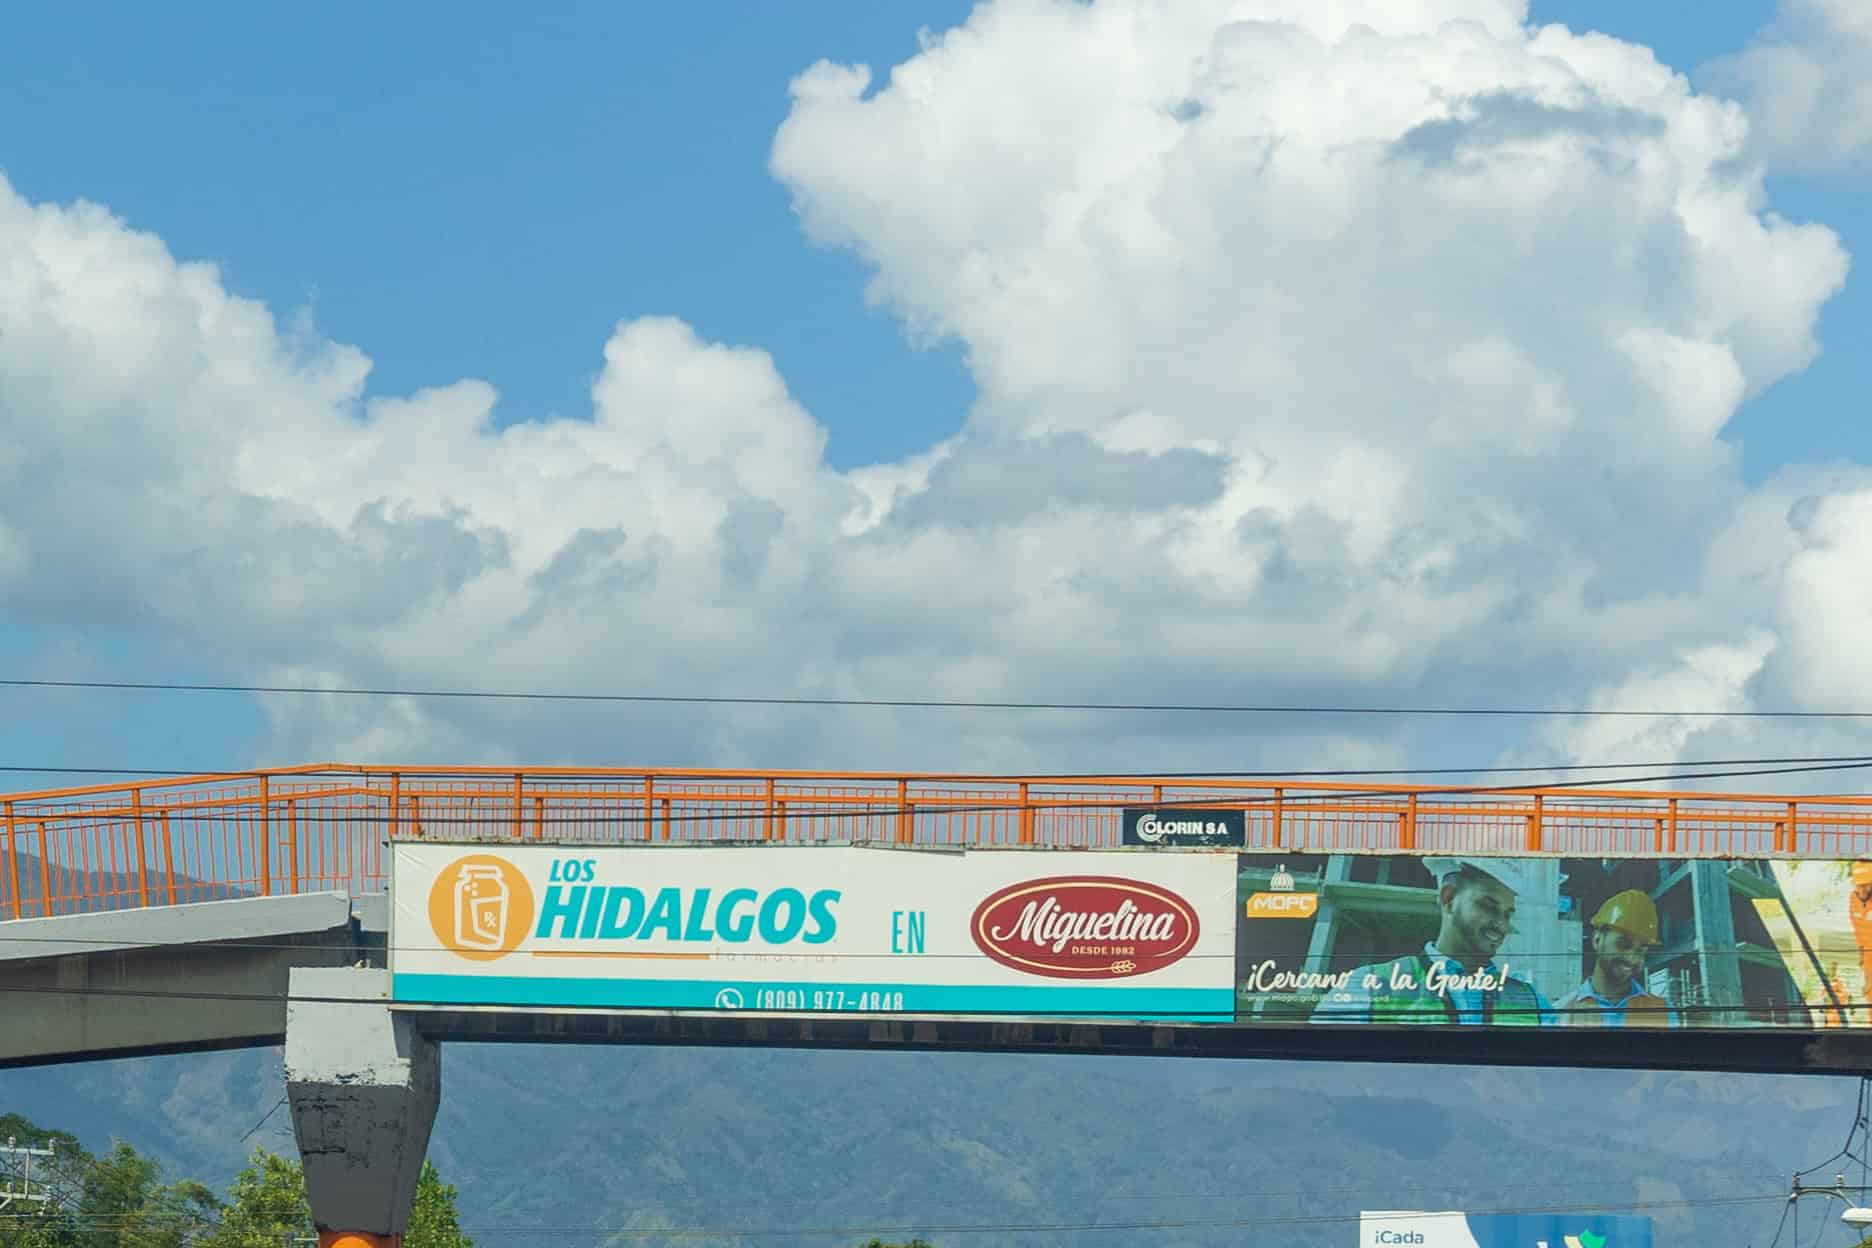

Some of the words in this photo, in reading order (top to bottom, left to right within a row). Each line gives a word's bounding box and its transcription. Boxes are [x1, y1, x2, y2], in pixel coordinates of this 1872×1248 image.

[1136, 814, 1204, 842] COLORIN
[1205, 822, 1228, 835] SA
[549, 859, 597, 882] LOS
[534, 885, 842, 945] HIDALGOS
[1252, 895, 1314, 911] MOPC
[891, 910, 926, 954] EN
[991, 896, 1176, 953] Miguelina
[1071, 946, 1108, 956] DESDE
[1110, 946, 1135, 956] 1982
[1247, 959, 1353, 992] ¡Cercano
[1363, 974, 1382, 990] a
[1390, 963, 1417, 991] la
[1425, 960, 1509, 997] Gente!
[1375, 1230, 1425, 1244] ¡Cada
